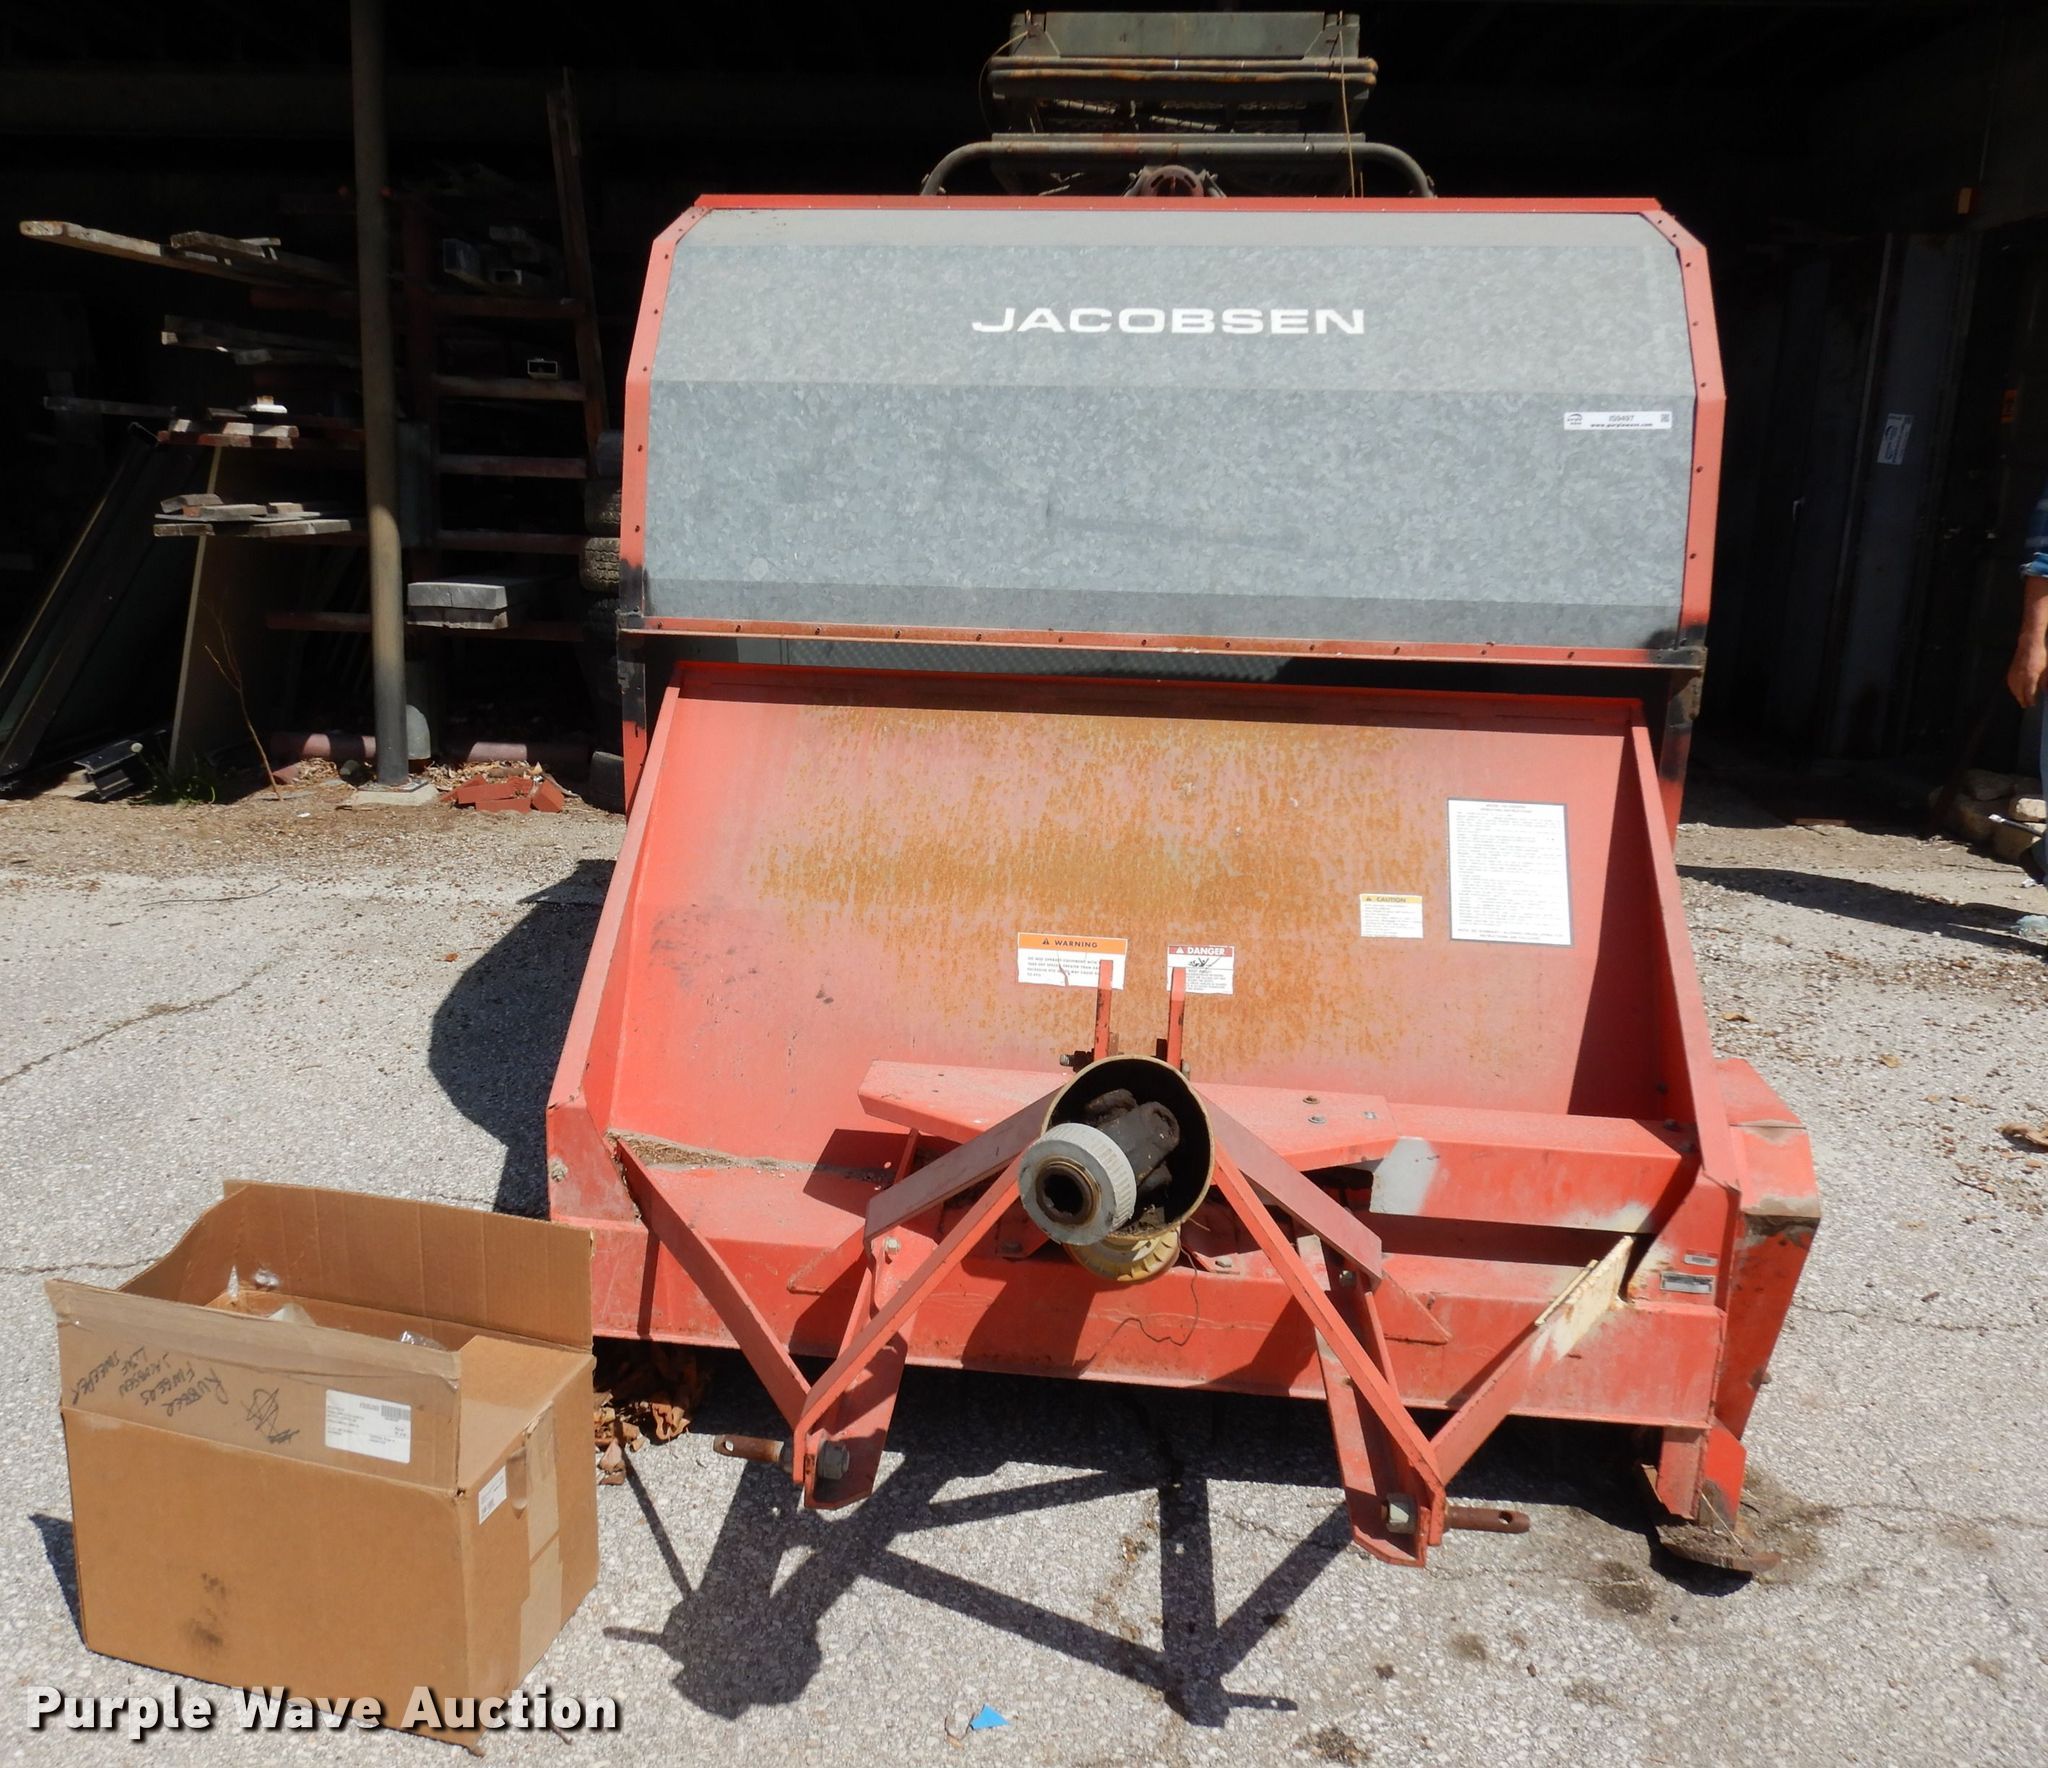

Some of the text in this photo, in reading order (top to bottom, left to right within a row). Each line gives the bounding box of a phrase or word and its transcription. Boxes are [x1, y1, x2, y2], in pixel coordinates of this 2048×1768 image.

[972, 307, 1365, 335] JACOBSEN
[1054, 939, 1098, 948] WARNING
[1187, 946, 1225, 956] DANGER
[161, 1367, 229, 1417] RUBBER
